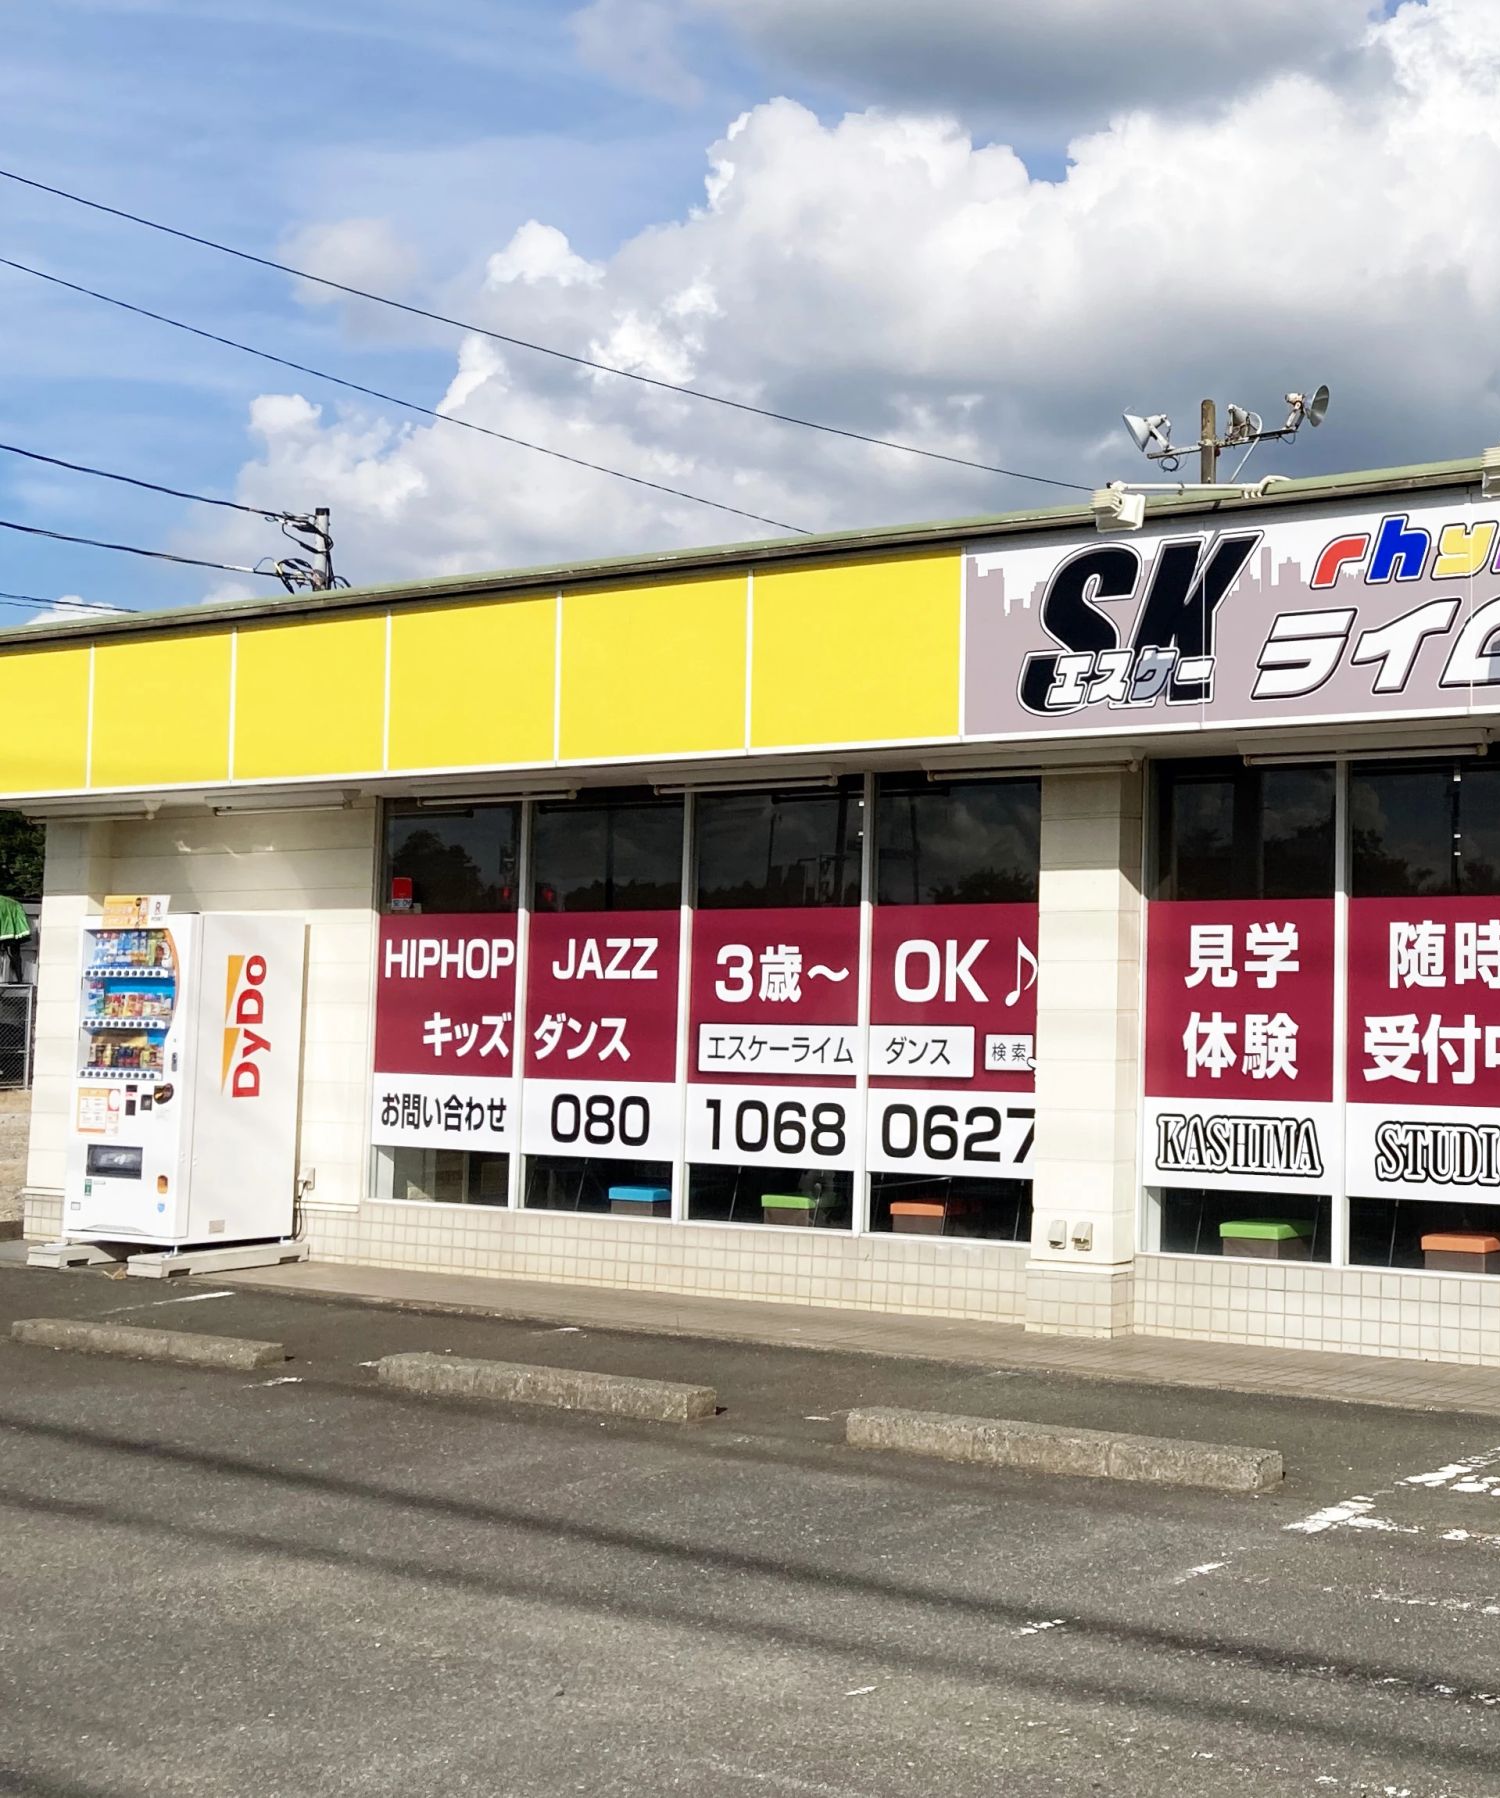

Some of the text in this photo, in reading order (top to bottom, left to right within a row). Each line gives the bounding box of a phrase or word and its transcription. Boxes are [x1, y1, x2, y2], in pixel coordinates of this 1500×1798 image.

[1017, 530, 1264, 717] SK
[1045, 645, 1216, 708] エスケー
[384, 937, 659, 980] HIPHOP JAZZ
[1184, 921, 1300, 989] 見学
[232, 954, 271, 1097] DyDo
[422, 1011, 631, 1062] キッズ ダンス
[707, 1035, 951, 1065] エスケーライム ダンス
[991, 1042, 1026, 1062] 検索
[1182, 1011, 1299, 1080] 体験
[381, 1093, 1035, 1164] お問い合わせ 080 1068 0627
[1156, 1114, 1325, 1178] KASHIMA
